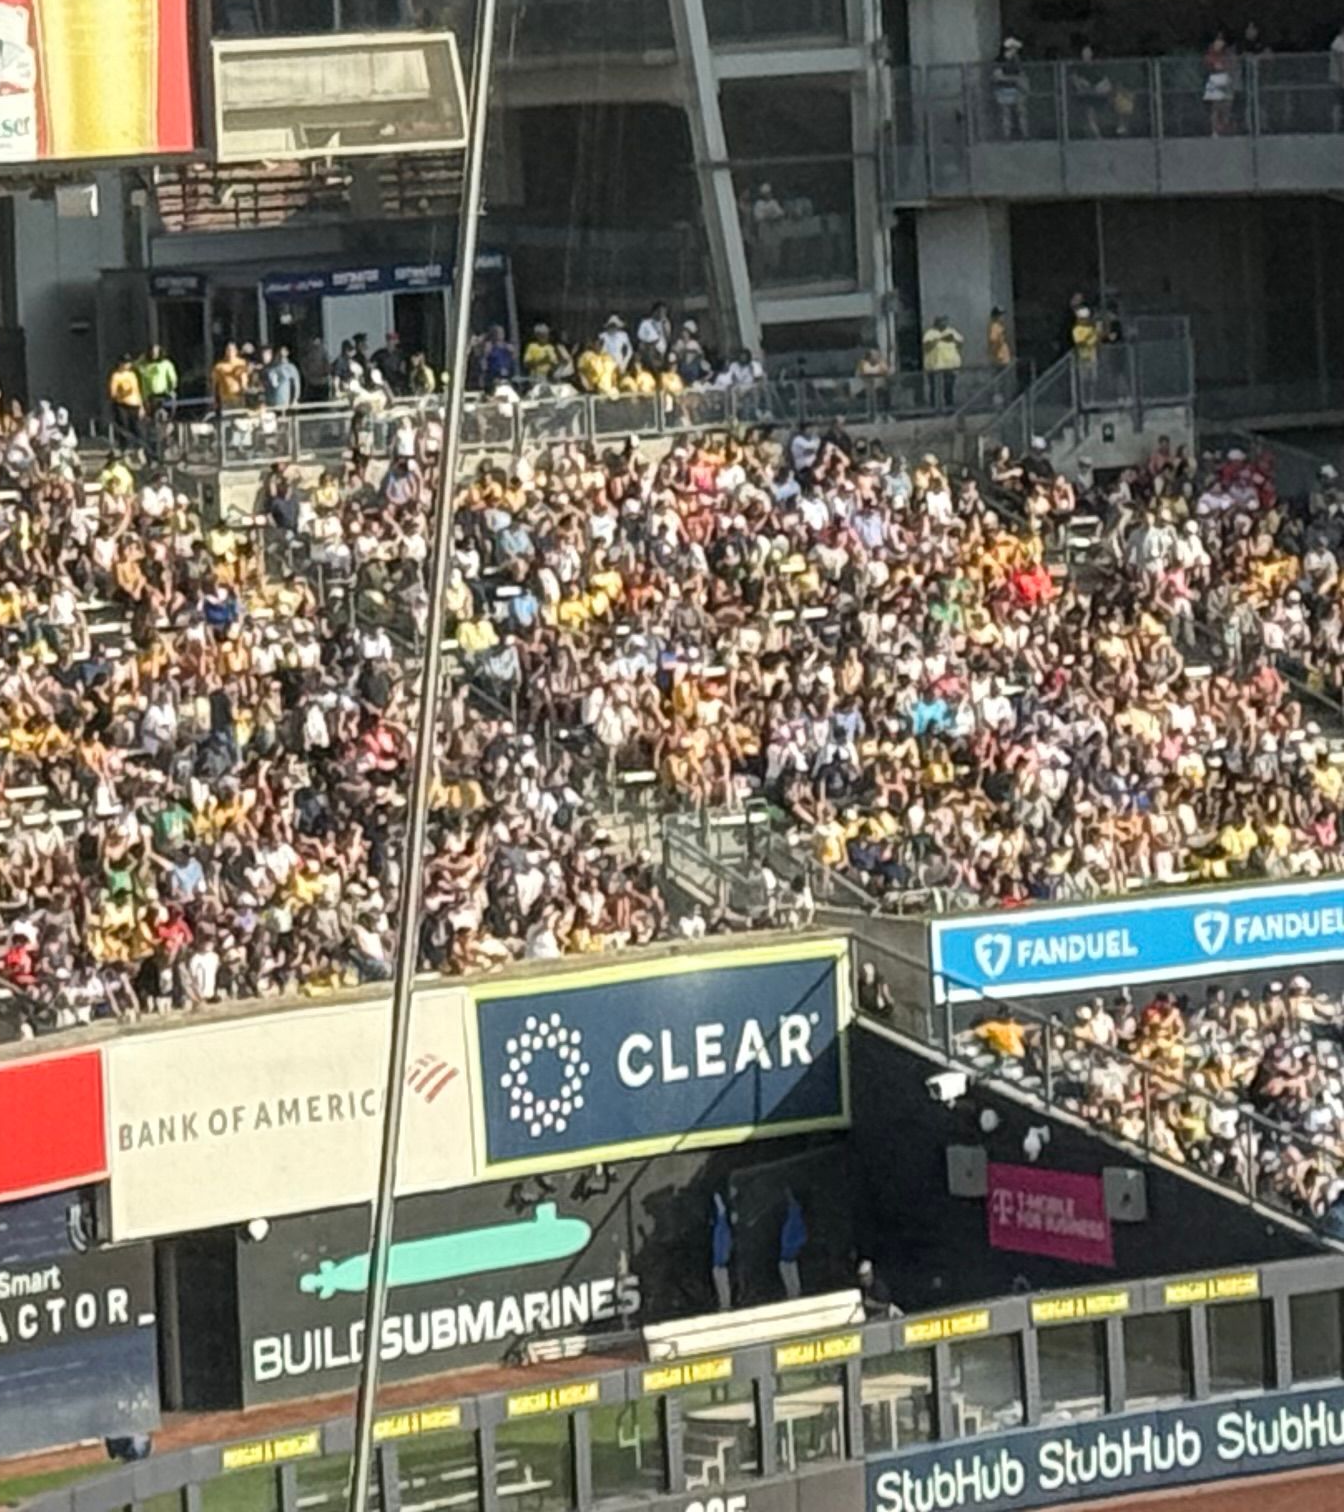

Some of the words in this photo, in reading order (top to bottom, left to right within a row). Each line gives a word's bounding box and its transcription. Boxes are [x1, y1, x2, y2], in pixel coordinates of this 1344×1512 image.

[1017, 928, 1138, 968] FANDUEL
[617, 1012, 814, 1088] CLEAR
[118, 1111, 199, 1152] BANK
[208, 1105, 247, 1136] OF
[253, 1088, 386, 1131] AMERIC
[876, 1447, 1024, 1512] StubHub
[1039, 1419, 1201, 1489] StubHub
[1217, 1402, 1344, 1460] StubHu
